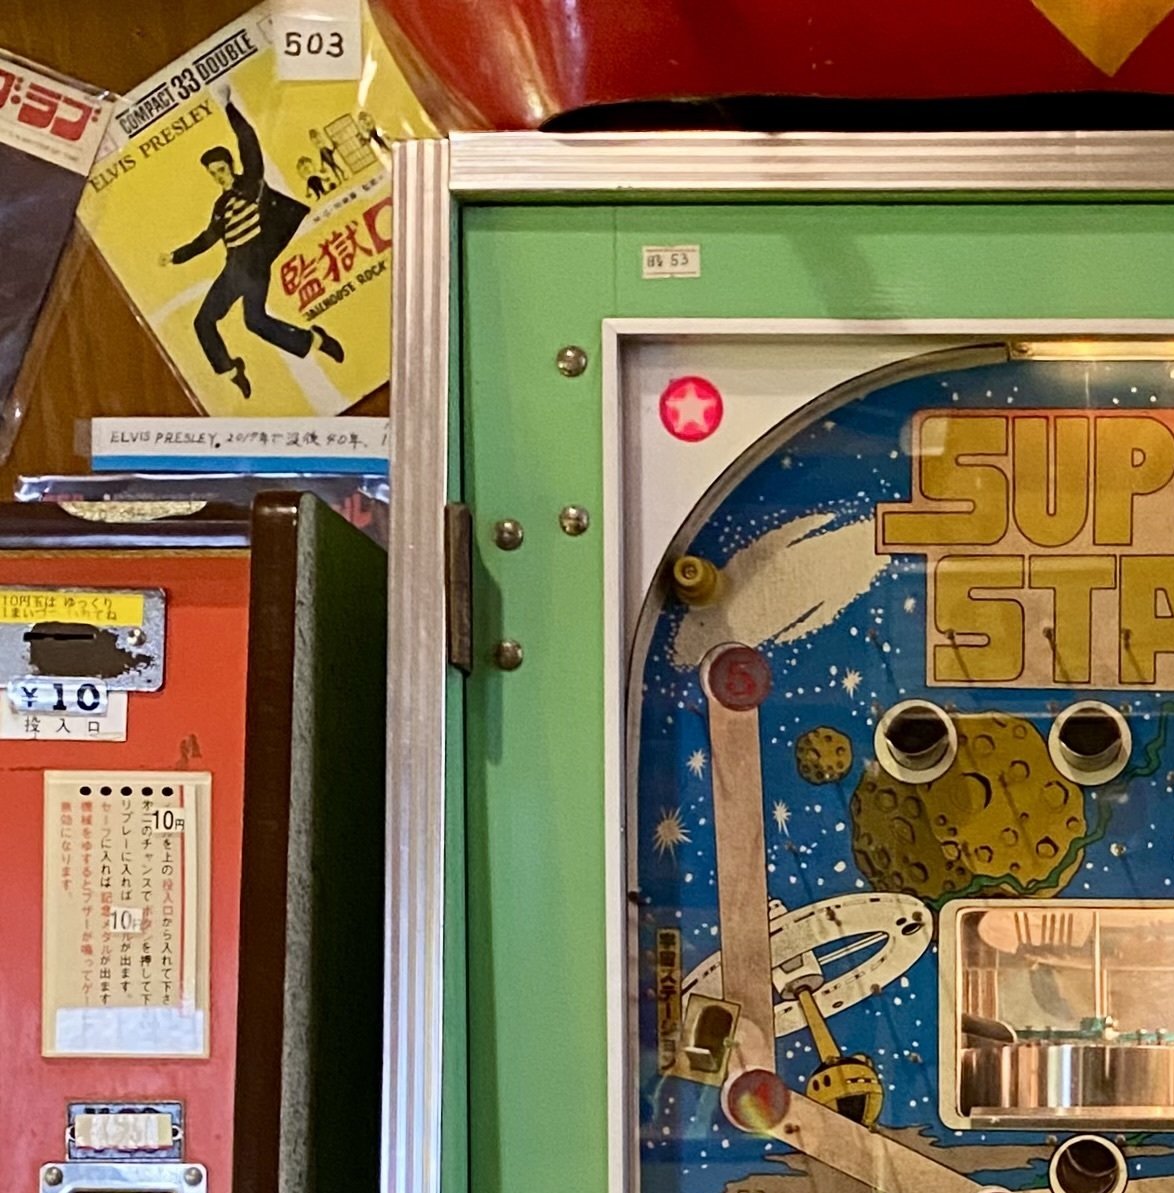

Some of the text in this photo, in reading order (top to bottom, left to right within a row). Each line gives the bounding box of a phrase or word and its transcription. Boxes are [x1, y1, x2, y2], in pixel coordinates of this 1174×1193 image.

[284, 32, 344, 58] 503
[119, 32, 255, 135] COMPACT 33 DOUBLE
[90, 155, 136, 193] ELVIS
[139, 101, 214, 158] PRESLEY
[670, 252, 689, 266] 53
[355, 260, 387, 285] ROCK
[110, 430, 151, 444] ELVIS
[64, 597, 112, 609] ゆっくり
[21, 683, 100, 711] ¥10
[25, 717, 100, 733] 投入口
[152, 810, 185, 831] 10円
